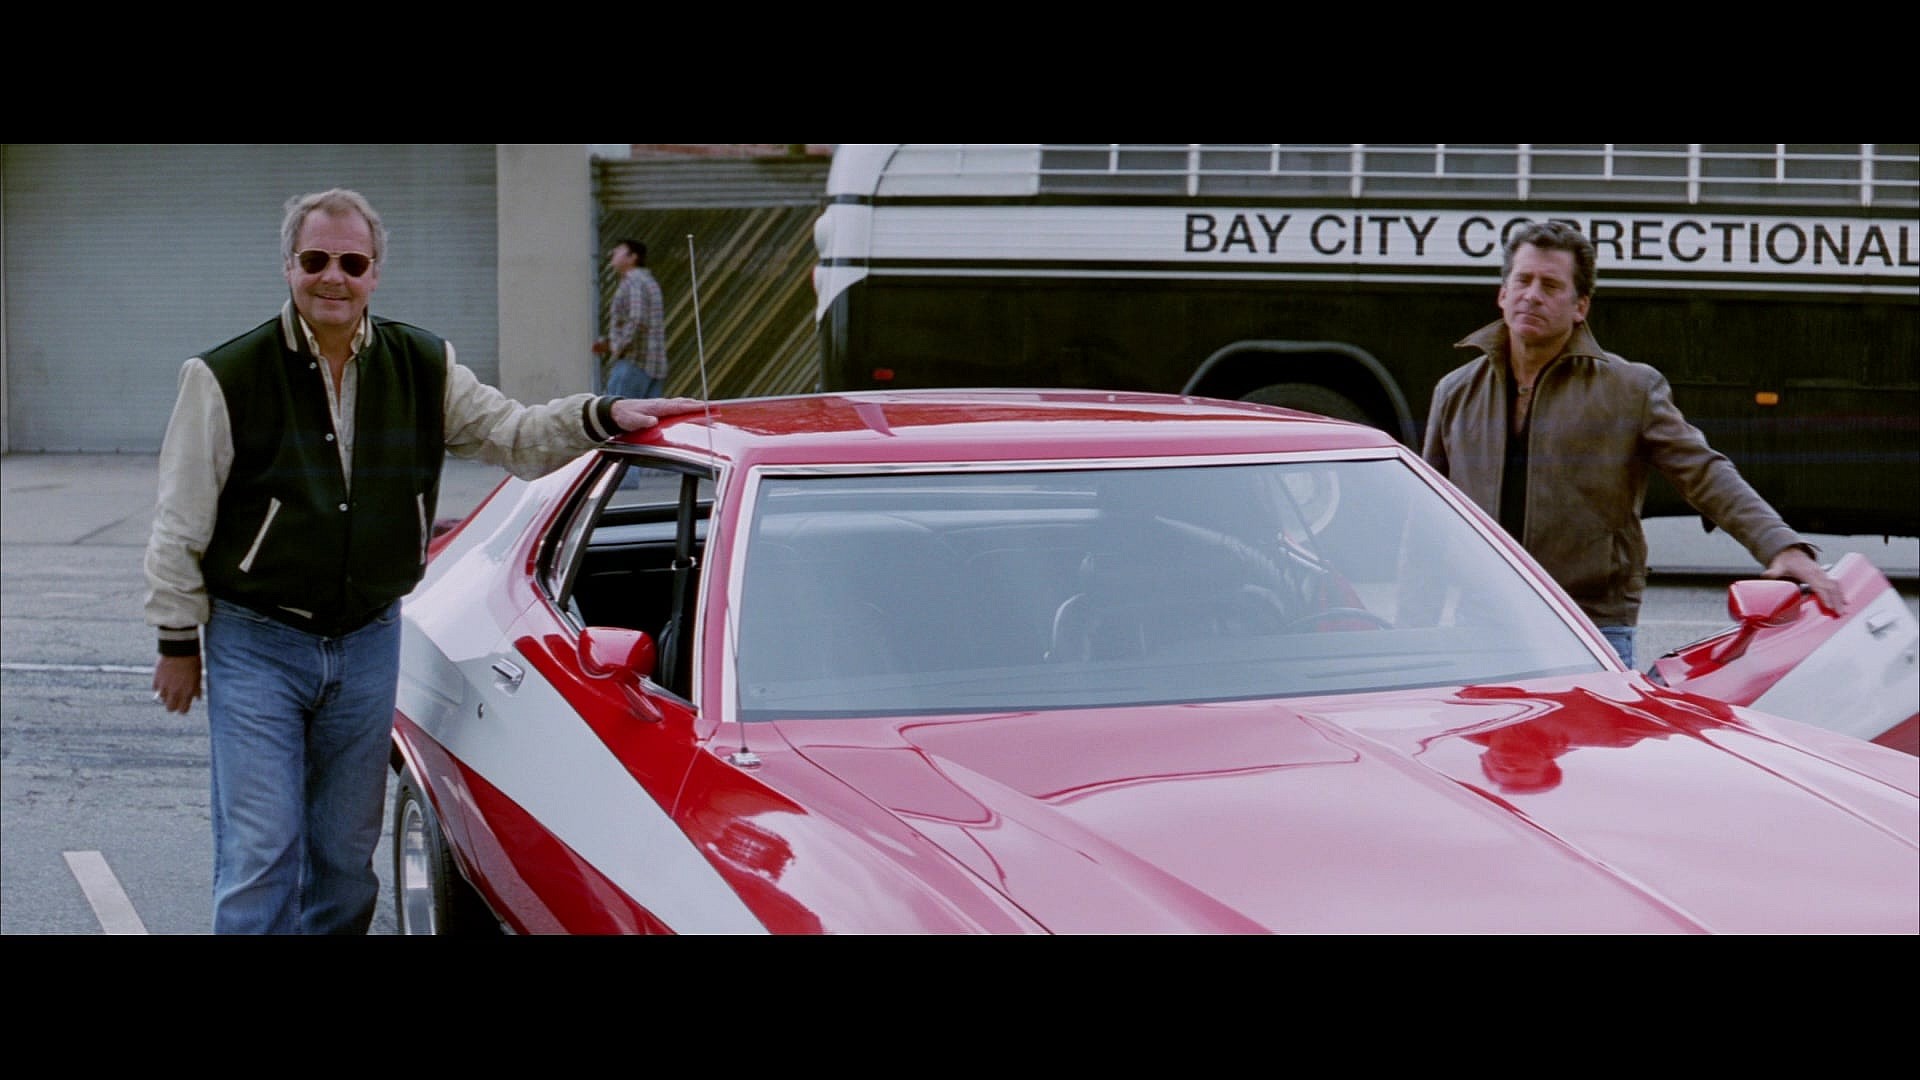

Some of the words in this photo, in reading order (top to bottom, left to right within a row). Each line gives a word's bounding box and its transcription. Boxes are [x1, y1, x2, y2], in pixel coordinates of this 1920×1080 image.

[1184, 213, 1292, 254] BAY
[1310, 214, 1439, 256] CITY
[1458, 216, 1919, 267] CRECTIONAL
